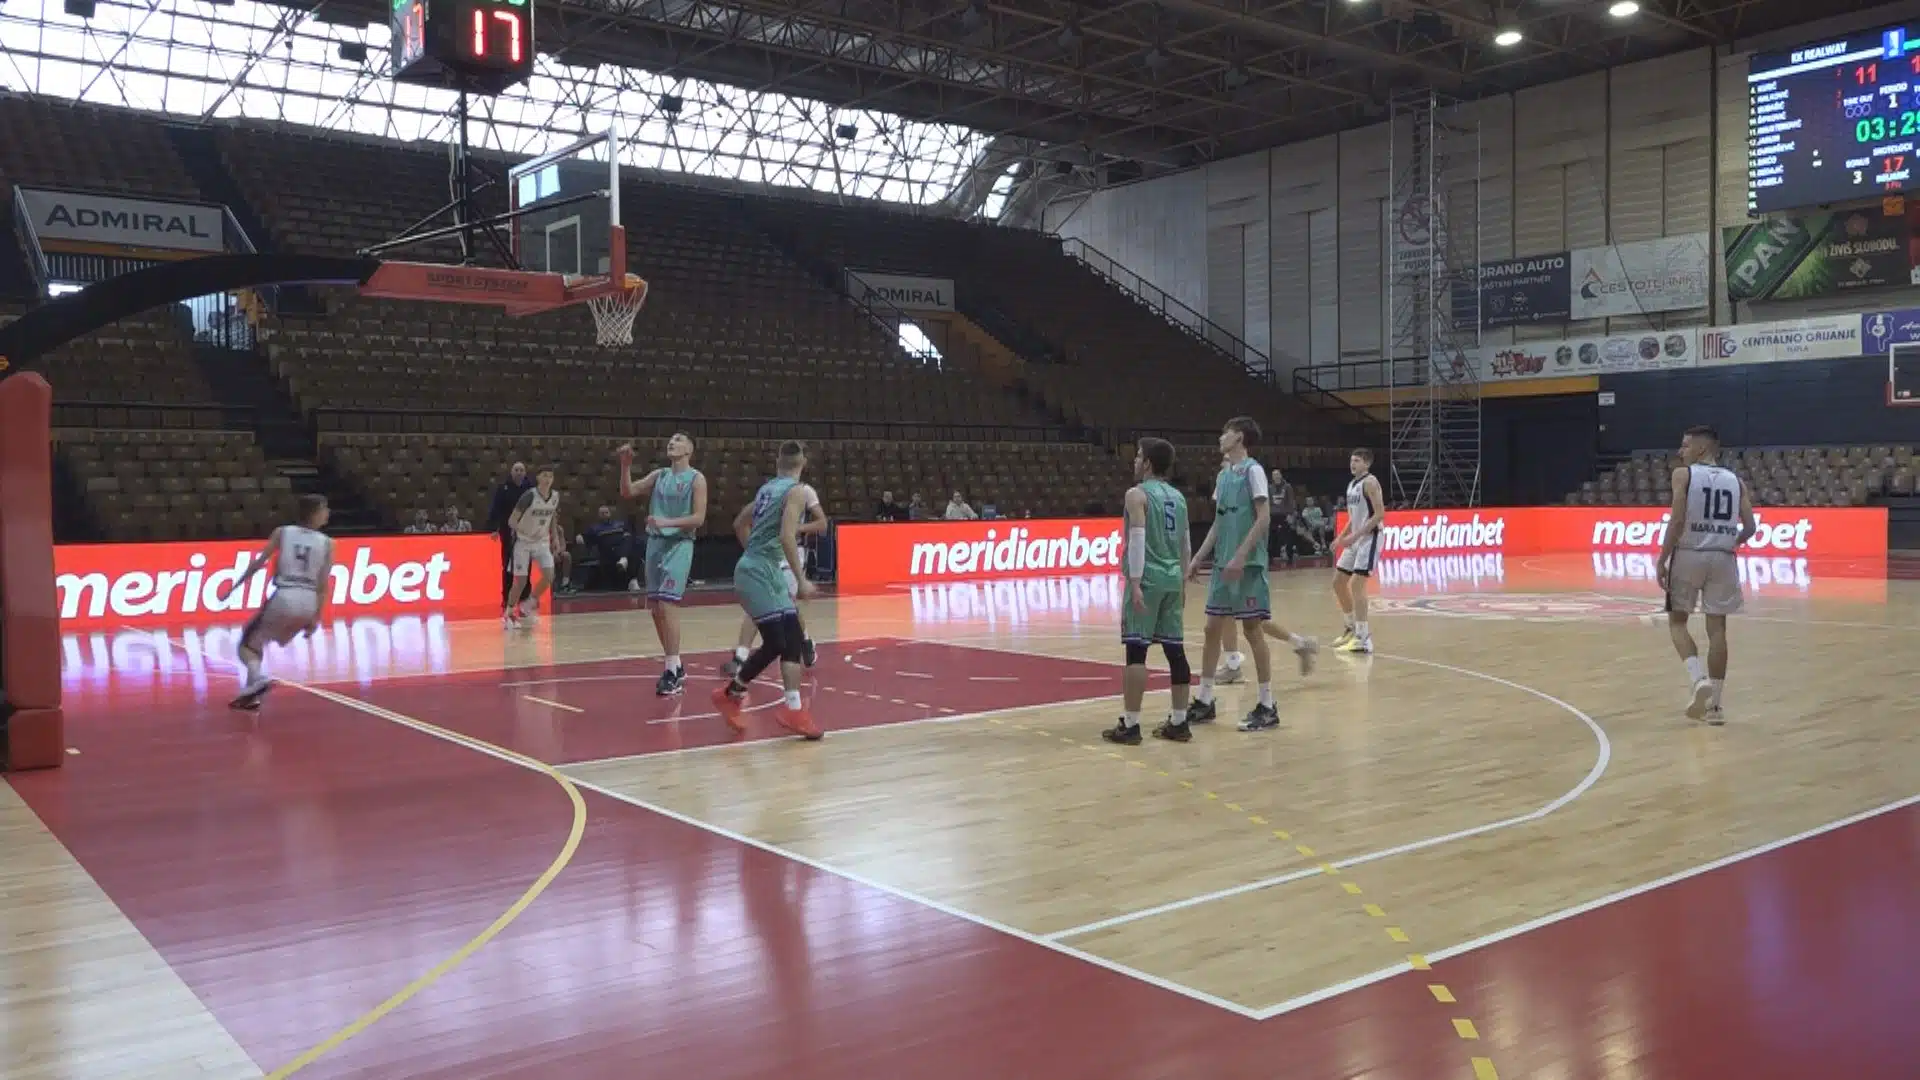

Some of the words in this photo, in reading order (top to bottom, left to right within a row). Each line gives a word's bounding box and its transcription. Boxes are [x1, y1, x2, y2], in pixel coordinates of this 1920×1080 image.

[405, 3, 424, 57] 17
[474, 10, 520, 62] 17
[1804, 41, 1848, 61] REALWAY
[1855, 63, 1877, 85] 11
[1888, 93, 1898, 109] 1
[1852, 170, 1863, 184] 3
[1884, 156, 1905, 173] 17
[45, 204, 210, 238] ADMIRAL
[1526, 257, 1565, 273] AUTO
[1741, 332, 1802, 349] CENTRALNO
[1805, 328, 1857, 342] GRIJANJE
[1702, 486, 1733, 520] 10
[1381, 512, 1505, 551] meridianbet
[1592, 512, 1812, 550] meribet
[291, 544, 312, 571] 4
[909, 525, 1122, 575] meridianbet
[55, 547, 451, 619] meridinbet
